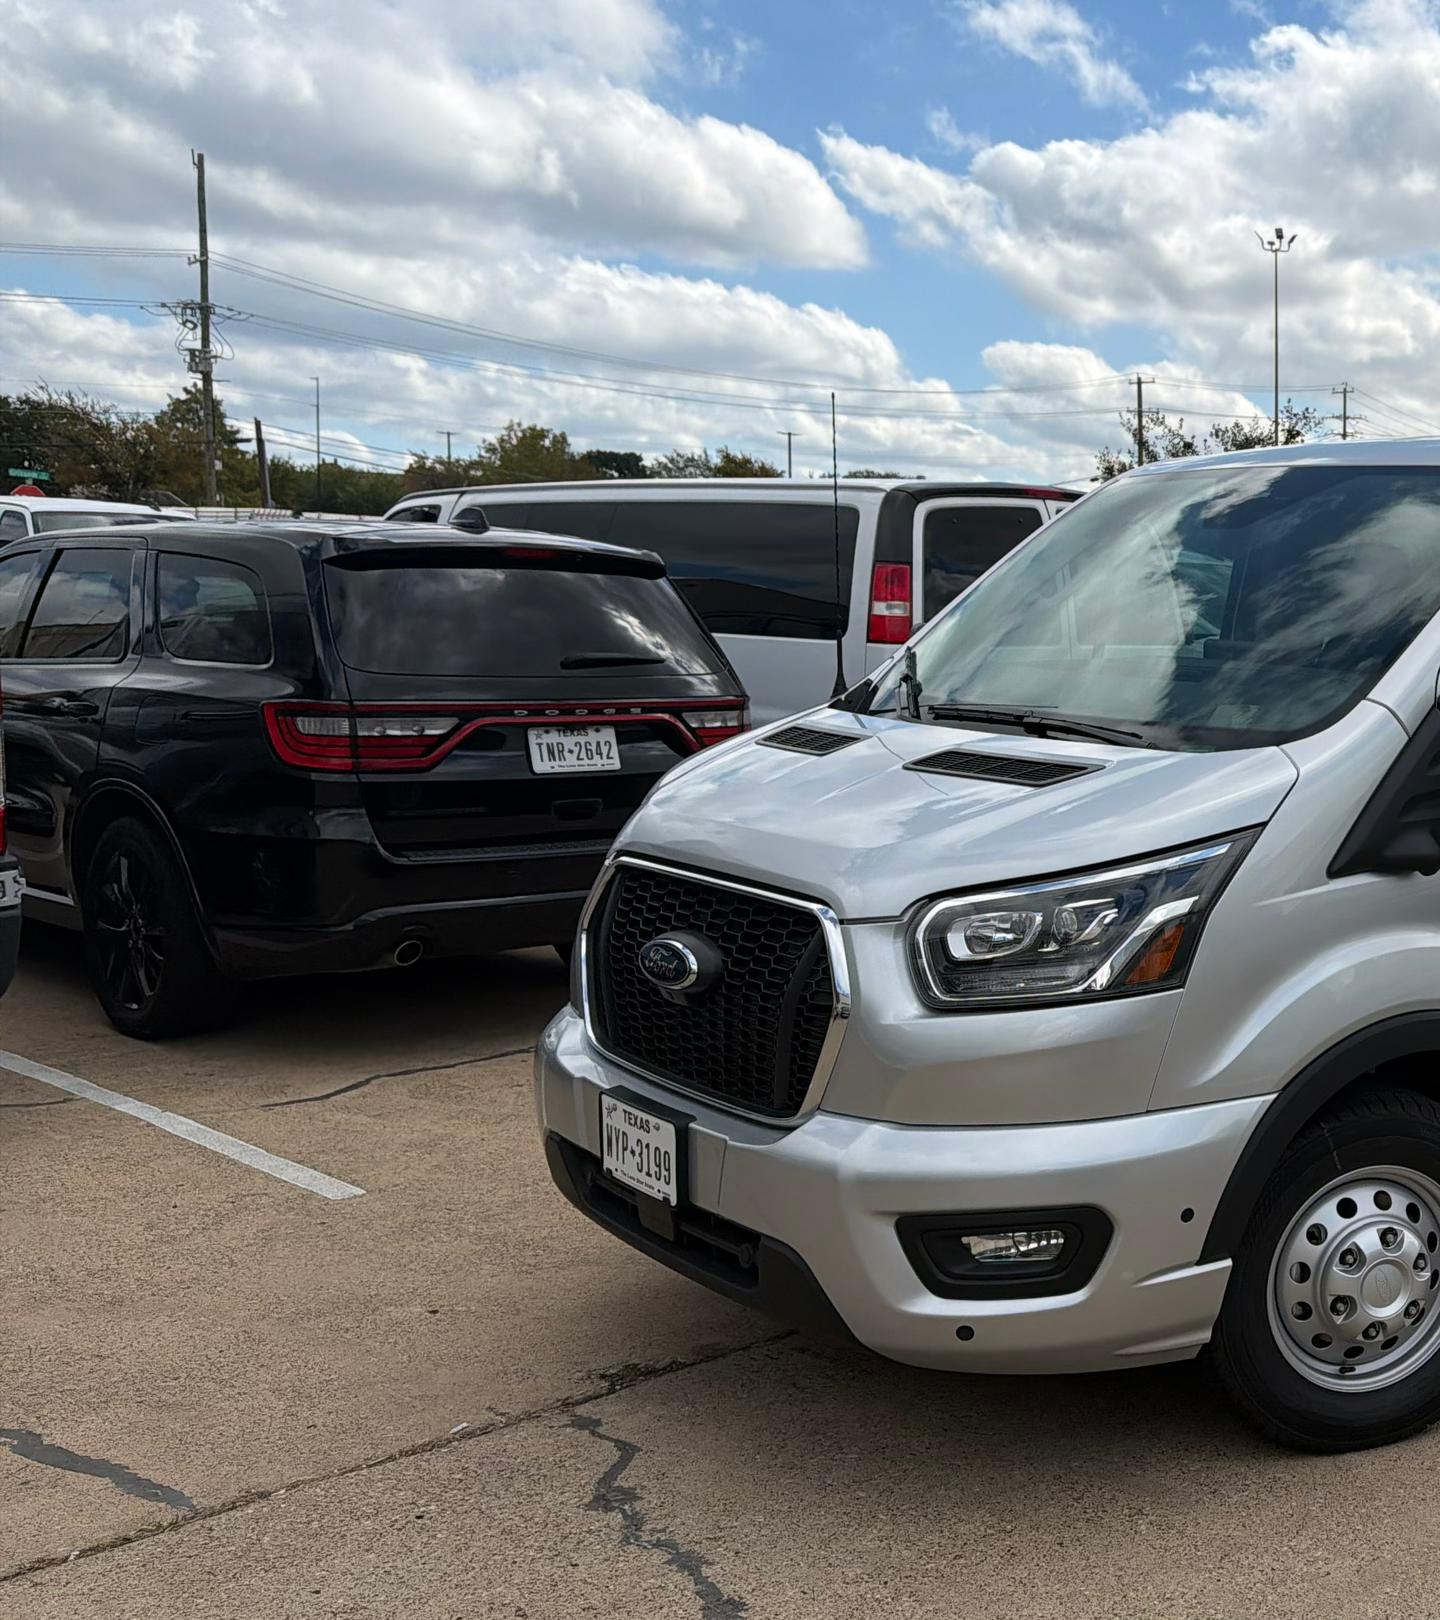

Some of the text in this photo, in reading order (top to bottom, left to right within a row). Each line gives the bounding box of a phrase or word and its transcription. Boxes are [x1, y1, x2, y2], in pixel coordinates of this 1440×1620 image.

[513, 708, 642, 717] DODGE
[557, 728, 589, 738] TEXAS
[645, 946, 679, 979] Ford
[622, 1108, 651, 1134] TEXAS
